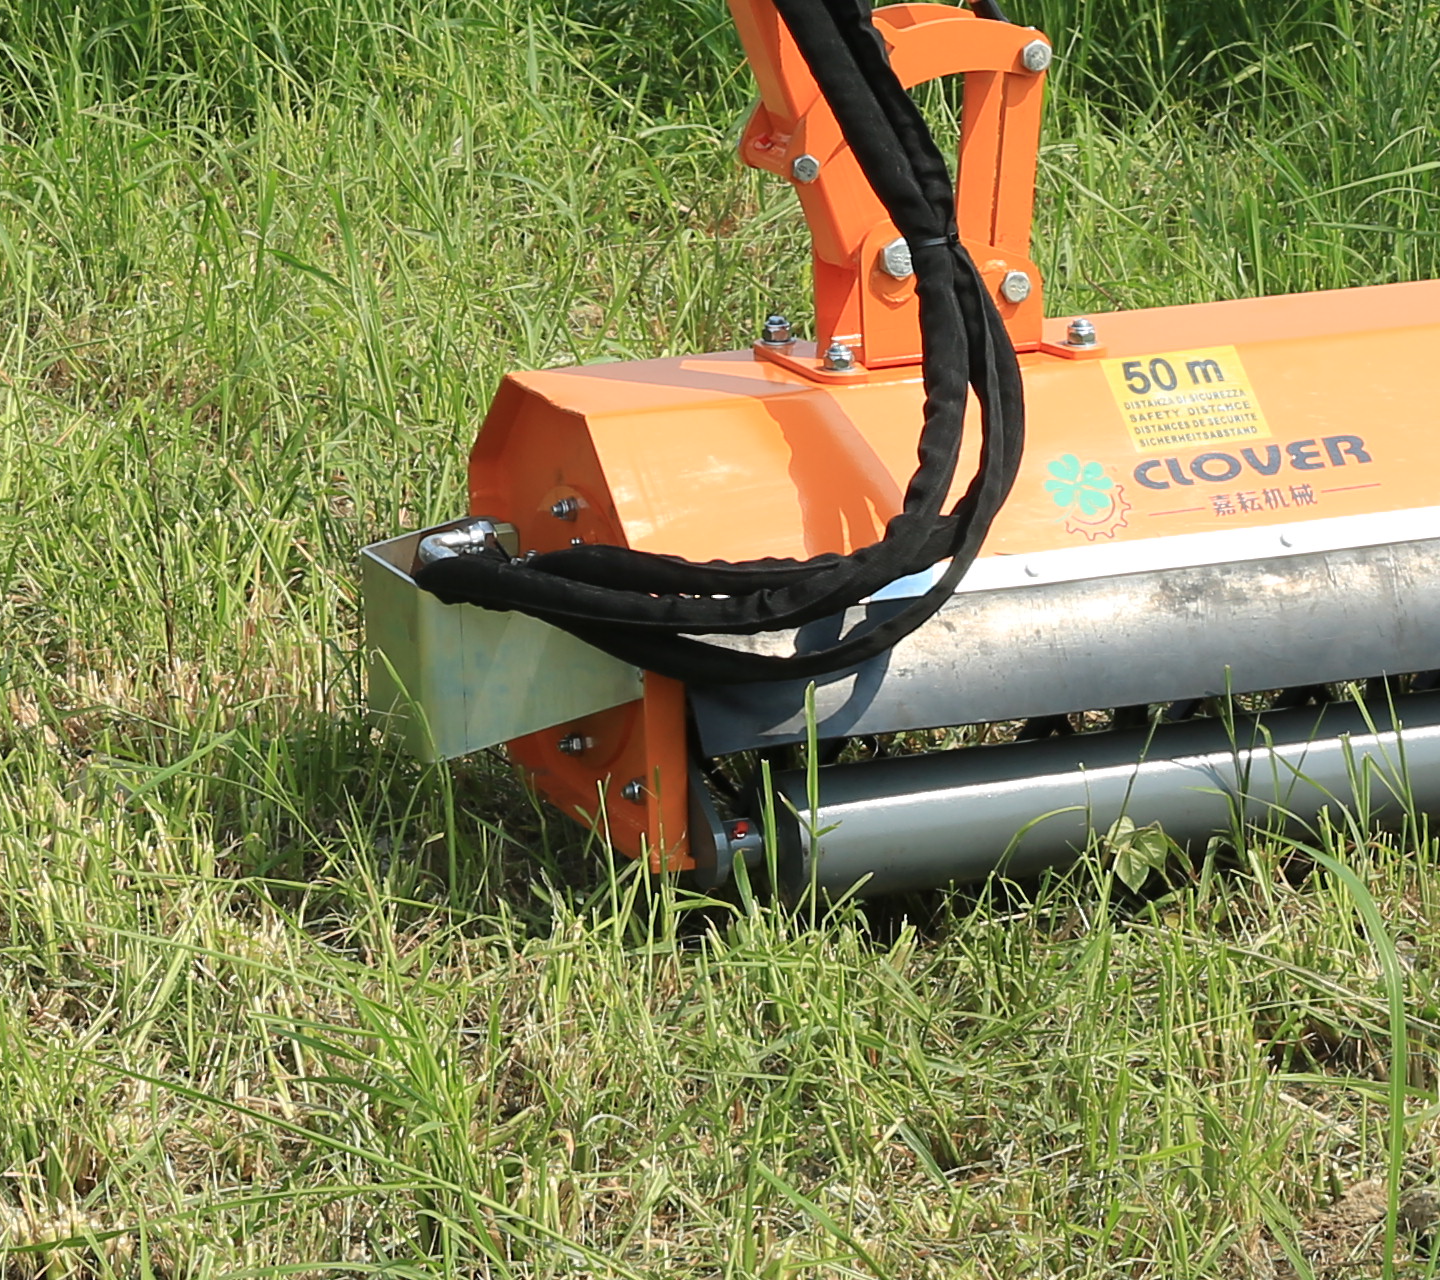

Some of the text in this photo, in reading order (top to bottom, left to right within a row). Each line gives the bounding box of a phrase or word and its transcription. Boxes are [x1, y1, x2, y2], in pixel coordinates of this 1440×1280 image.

[1122, 357, 1225, 395] 50 m
[1123, 388, 1247, 410] DISTANZA DI SICUREZZA
[1129, 409, 1180, 423] SAFETY
[1133, 412, 1258, 435] DISTANCES DE SECURITE
[1138, 425, 1258, 447] SICHERHEITSABSTAND
[1132, 434, 1373, 490] CLOVER
[1209, 483, 1319, 517] 嘉耘机械
